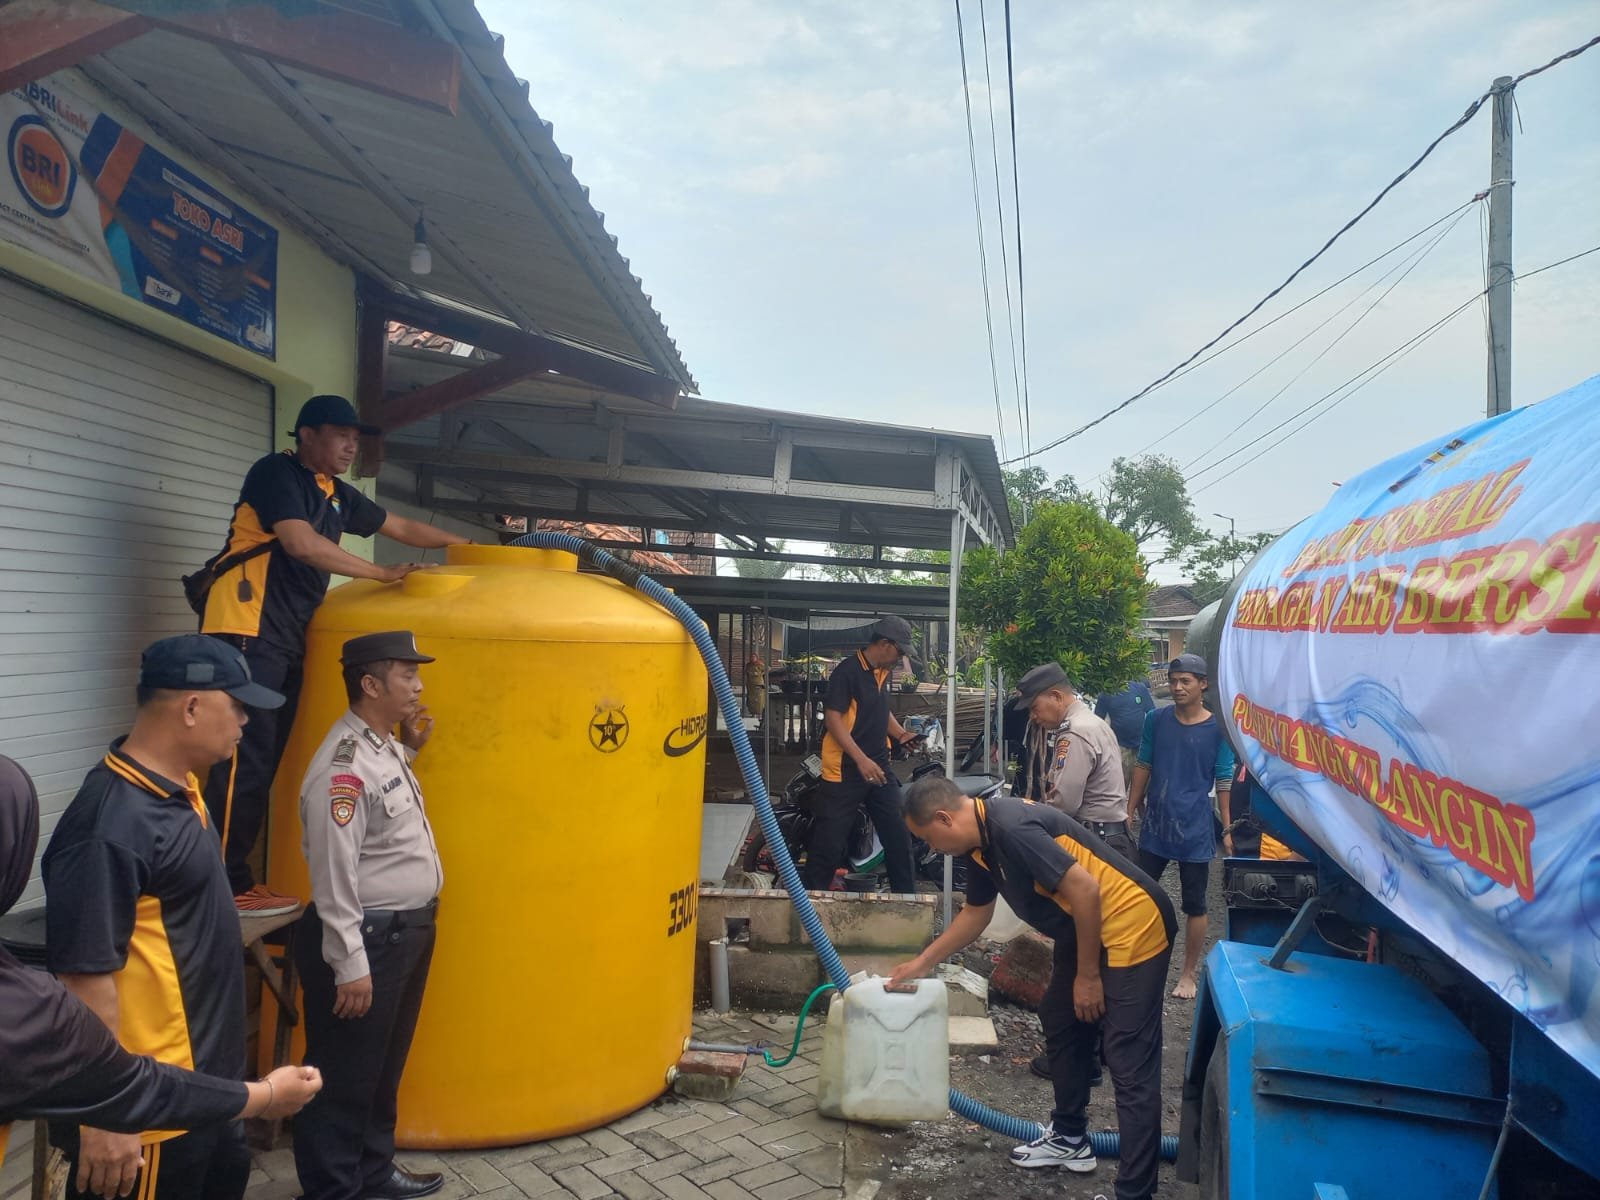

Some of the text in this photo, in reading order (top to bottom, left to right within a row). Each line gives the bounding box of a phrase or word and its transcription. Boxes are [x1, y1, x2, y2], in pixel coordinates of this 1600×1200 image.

[22, 143, 61, 187] BRI
[172, 191, 211, 233] TOKO
[211, 217, 244, 253] ASRI
[1332, 568, 1402, 632] AIR
[668, 881, 695, 937] 3300
